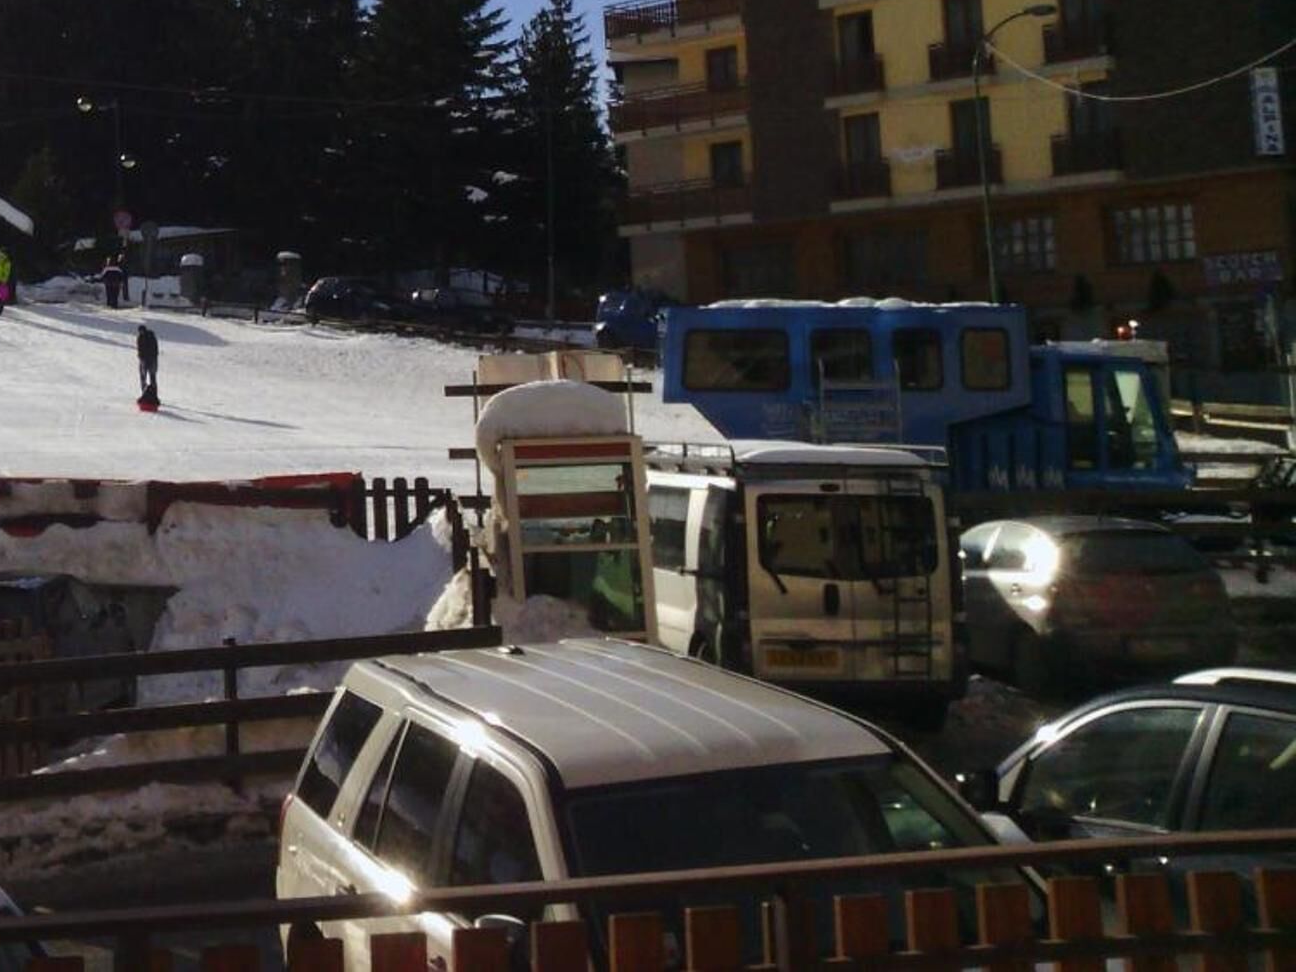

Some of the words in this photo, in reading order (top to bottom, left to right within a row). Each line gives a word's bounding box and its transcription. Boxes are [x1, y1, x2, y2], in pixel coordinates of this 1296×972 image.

[1262, 94, 1279, 152] ALPINA
[1203, 251, 1277, 270] SCOTCH
[1219, 268, 1262, 284] BAR
